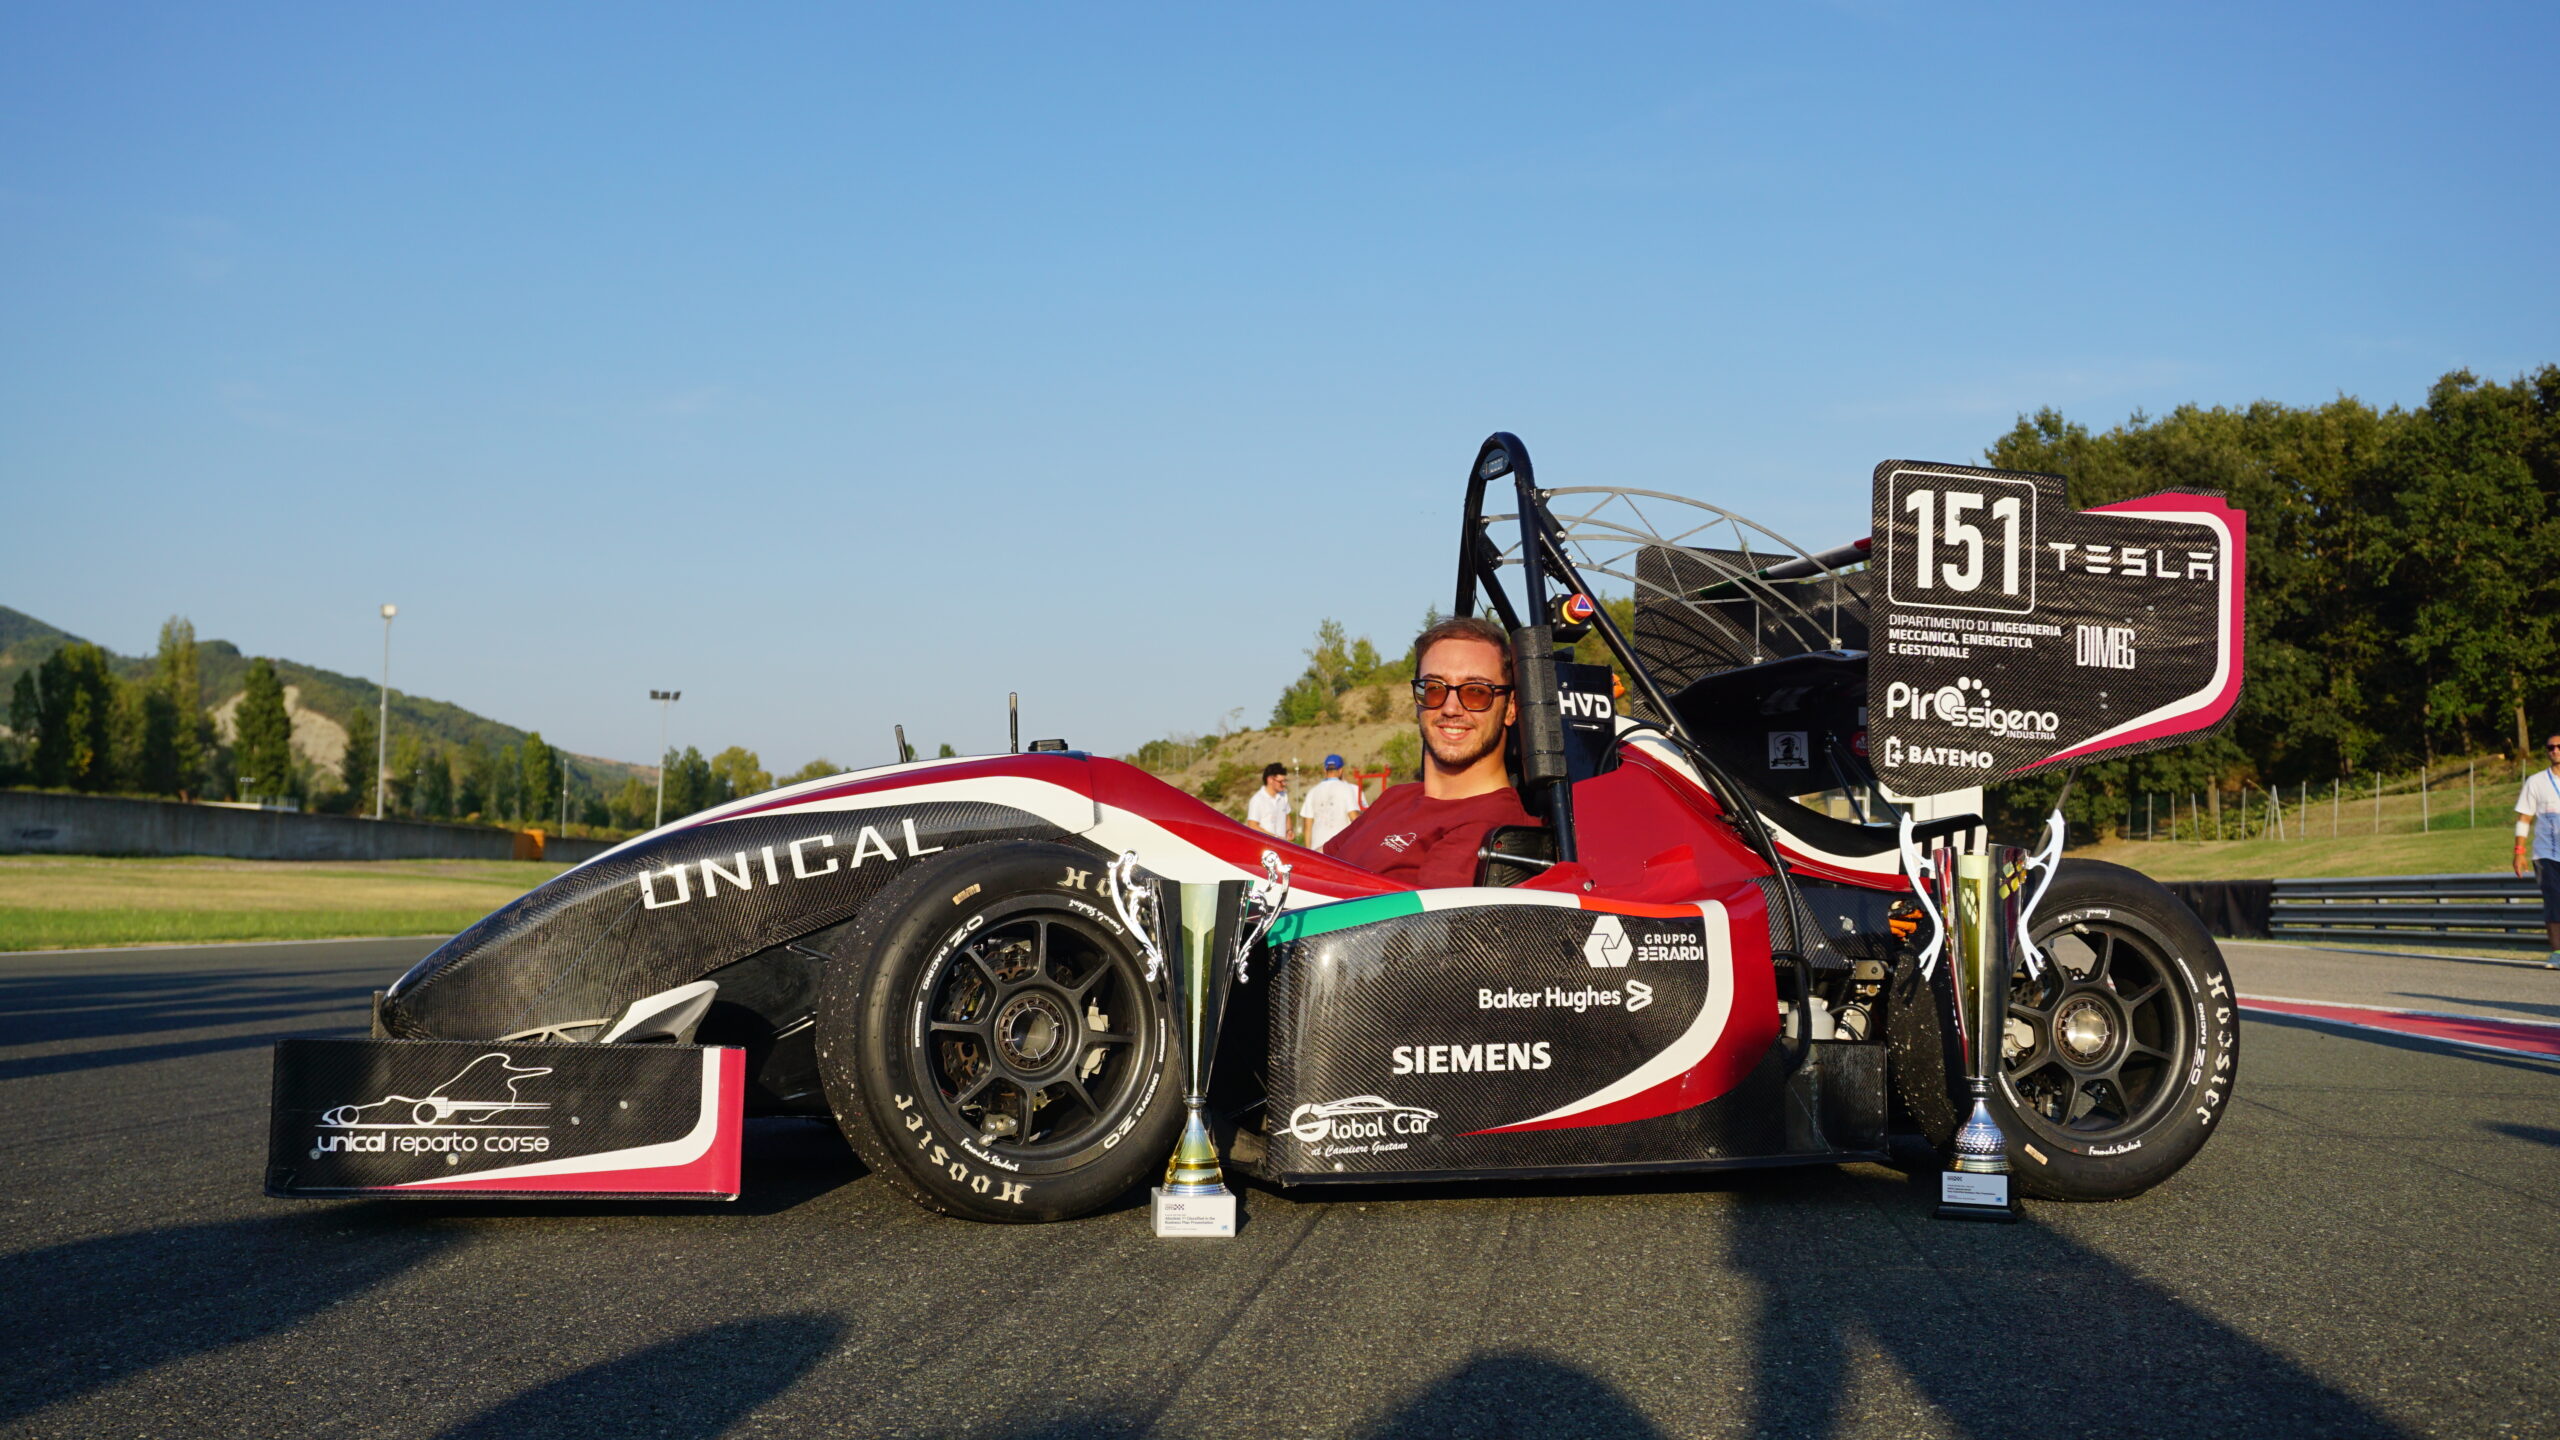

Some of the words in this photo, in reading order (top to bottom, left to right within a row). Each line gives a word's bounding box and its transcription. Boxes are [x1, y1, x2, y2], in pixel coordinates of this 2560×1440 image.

[1905, 489, 2021, 596] 151
[2047, 542, 2214, 581] TESLA
[1888, 614, 1975, 631] DIPARTIMENTO
[1977, 621, 1989, 631] DI
[1991, 621, 2062, 637] INGEGNERIA
[1888, 628, 1960, 646] MECCANICA,
[1962, 633, 2033, 649] ENERGETICA
[1888, 643, 1896, 654] E
[1899, 643, 1970, 659] GESTIONALE
[2076, 624, 2136, 670] DIMEG
[2006, 730, 2057, 740] INDUSTRIA
[1908, 745, 1994, 769] BATEMO
[638, 818, 944, 909] UNICAL
[1637, 946, 1704, 961] BERARDI
[1644, 933, 1697, 945] GRUPPO
[922, 946, 949, 991] RACING
[1478, 987, 1542, 1009] Baker
[1545, 984, 1621, 1013] Hughes
[2197, 1002, 2207, 1045] RACING
[1392, 1041, 1552, 1075] SIEMENS
[2196, 971, 2234, 1126] Hoosier
[1136, 1073, 1160, 1117] RACING
[1290, 1103, 1387, 1142] Global
[1393, 1112, 1431, 1134] Car
[317, 1131, 386, 1152] unical
[392, 1131, 478, 1157] reparto
[484, 1136, 550, 1152] corse
[894, 1094, 1032, 1205] Hoosier
[960, 1138, 990, 1162] Formula
[989, 1155, 1020, 1172] Student
[1371, 1141, 1409, 1155] Gaetano
[2088, 1144, 2116, 1156] Formula
[2116, 1139, 2142, 1154] Student
